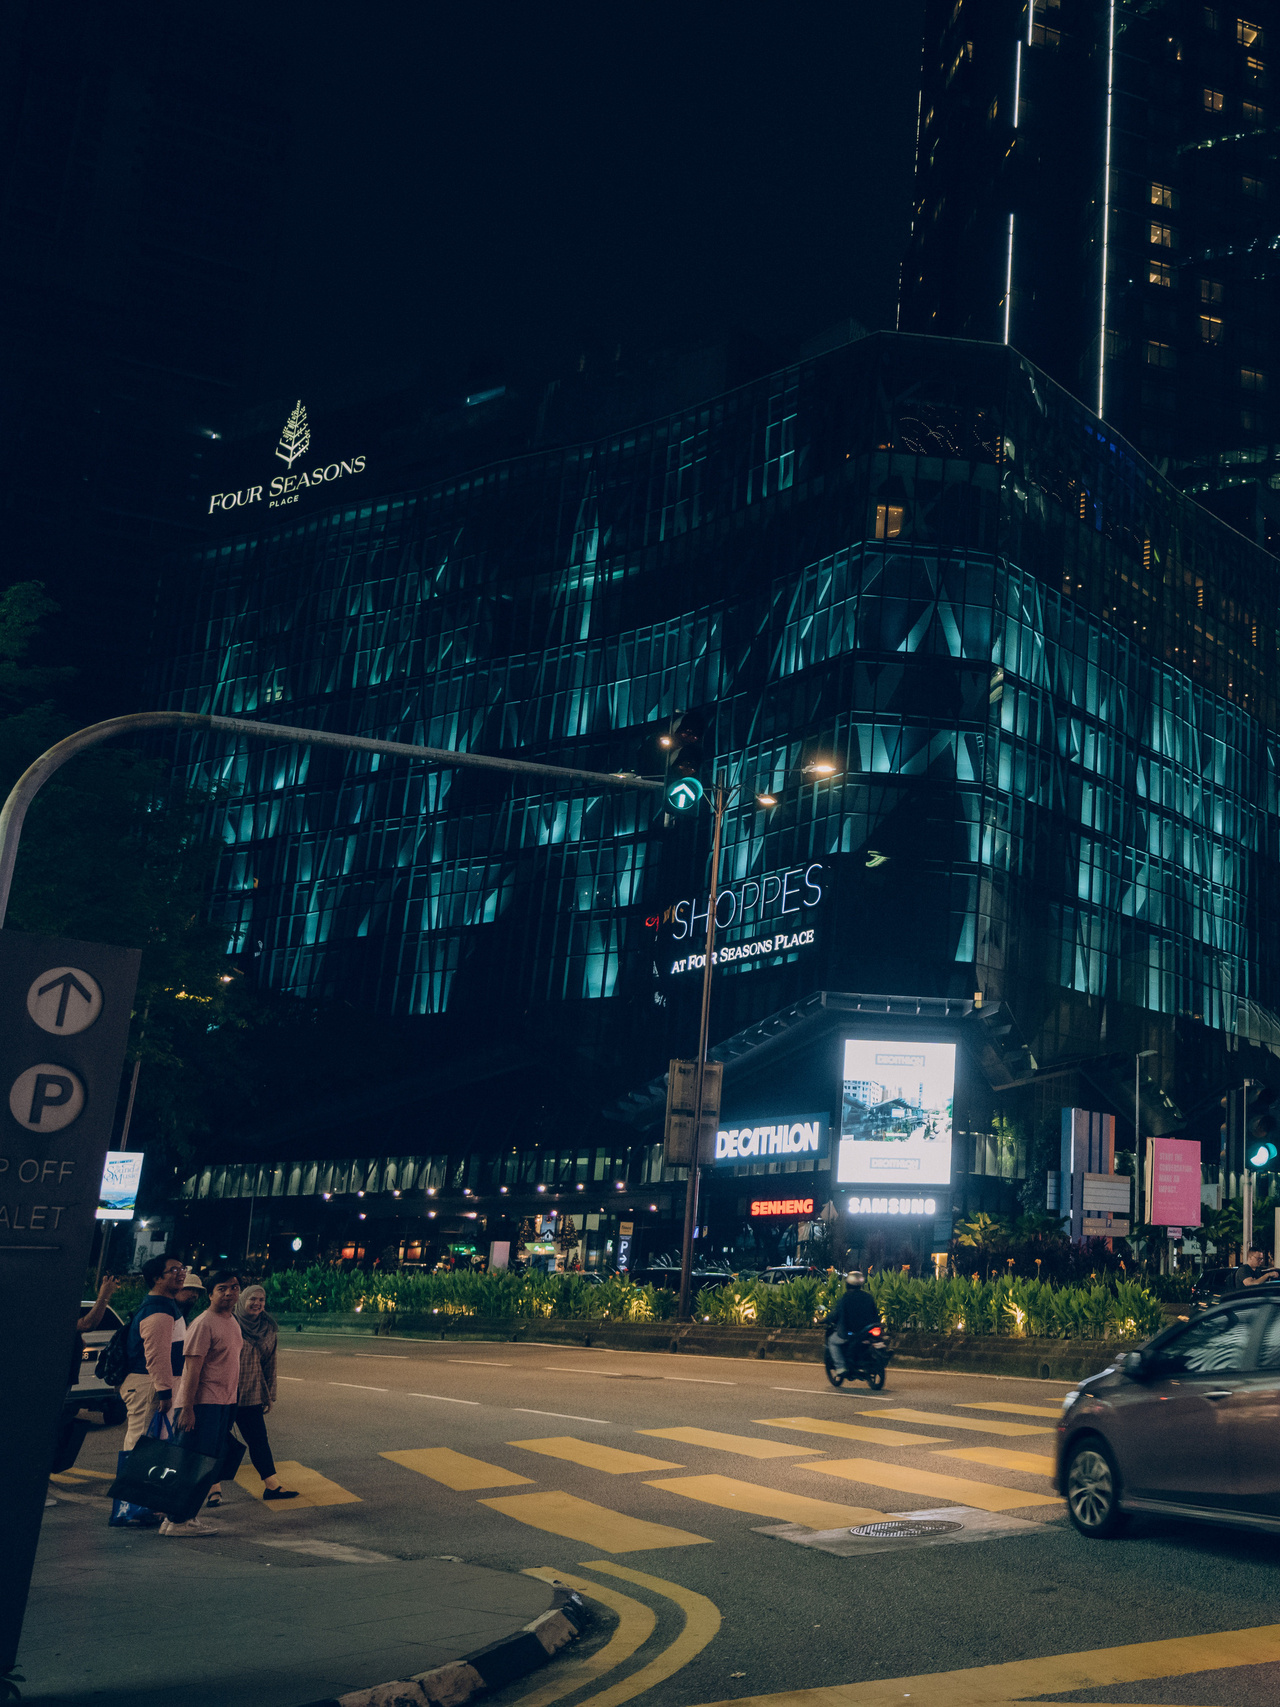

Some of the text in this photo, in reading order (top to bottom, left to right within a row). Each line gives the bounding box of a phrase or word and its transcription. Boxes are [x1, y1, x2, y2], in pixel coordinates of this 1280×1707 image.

[208, 455, 366, 514] FOUR SEASONS
[269, 495, 299, 508] PLACE
[672, 863, 823, 940] SHOPPES
[670, 959, 687, 974] AT
[719, 939, 773, 962] SEASONS
[774, 929, 815, 951] PLACE
[29, 1073, 74, 1125] P
[714, 1121, 820, 1159] DECATHLON
[18, 1159, 76, 1184] OFF
[0, 1204, 66, 1230] ALET
[751, 1198, 814, 1216] SENHENG
[848, 1197, 936, 1215] SAMSUNG
